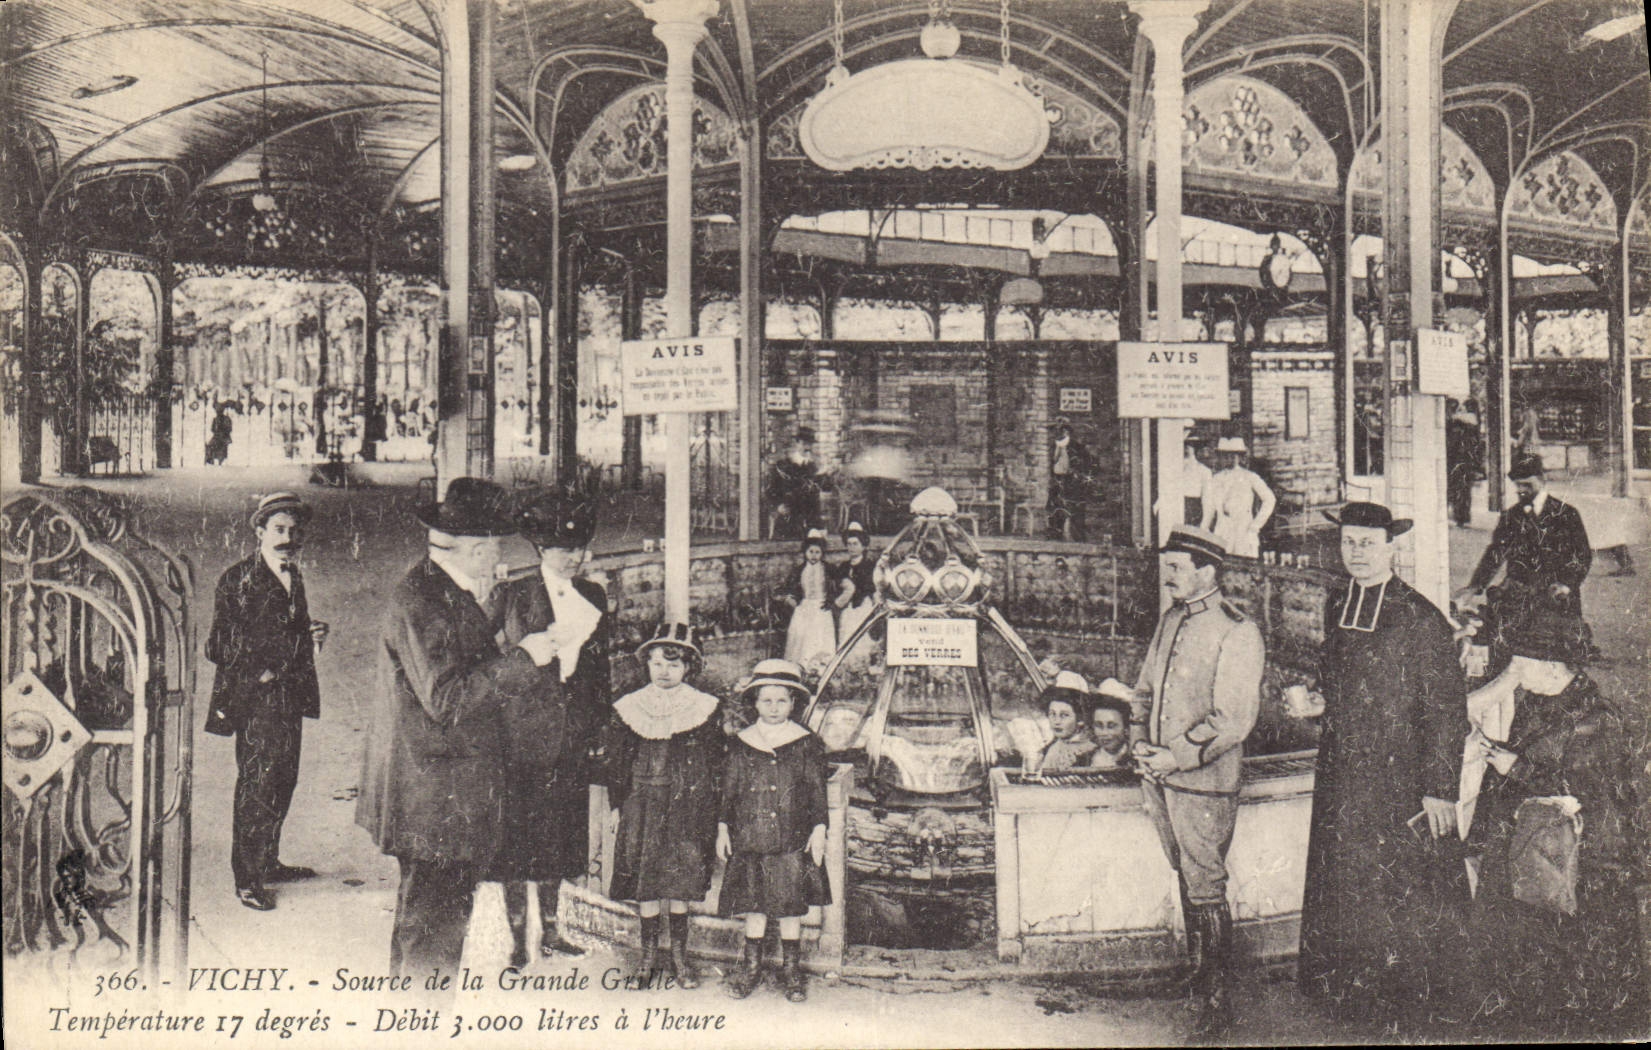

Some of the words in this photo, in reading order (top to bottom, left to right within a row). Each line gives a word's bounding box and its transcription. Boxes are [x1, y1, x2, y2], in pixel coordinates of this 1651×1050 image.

[652, 344, 705, 359] AVIS
[1147, 351, 1199, 364] AVIS
[902, 648, 919, 658] DES
[924, 648, 961, 659] VERRES
